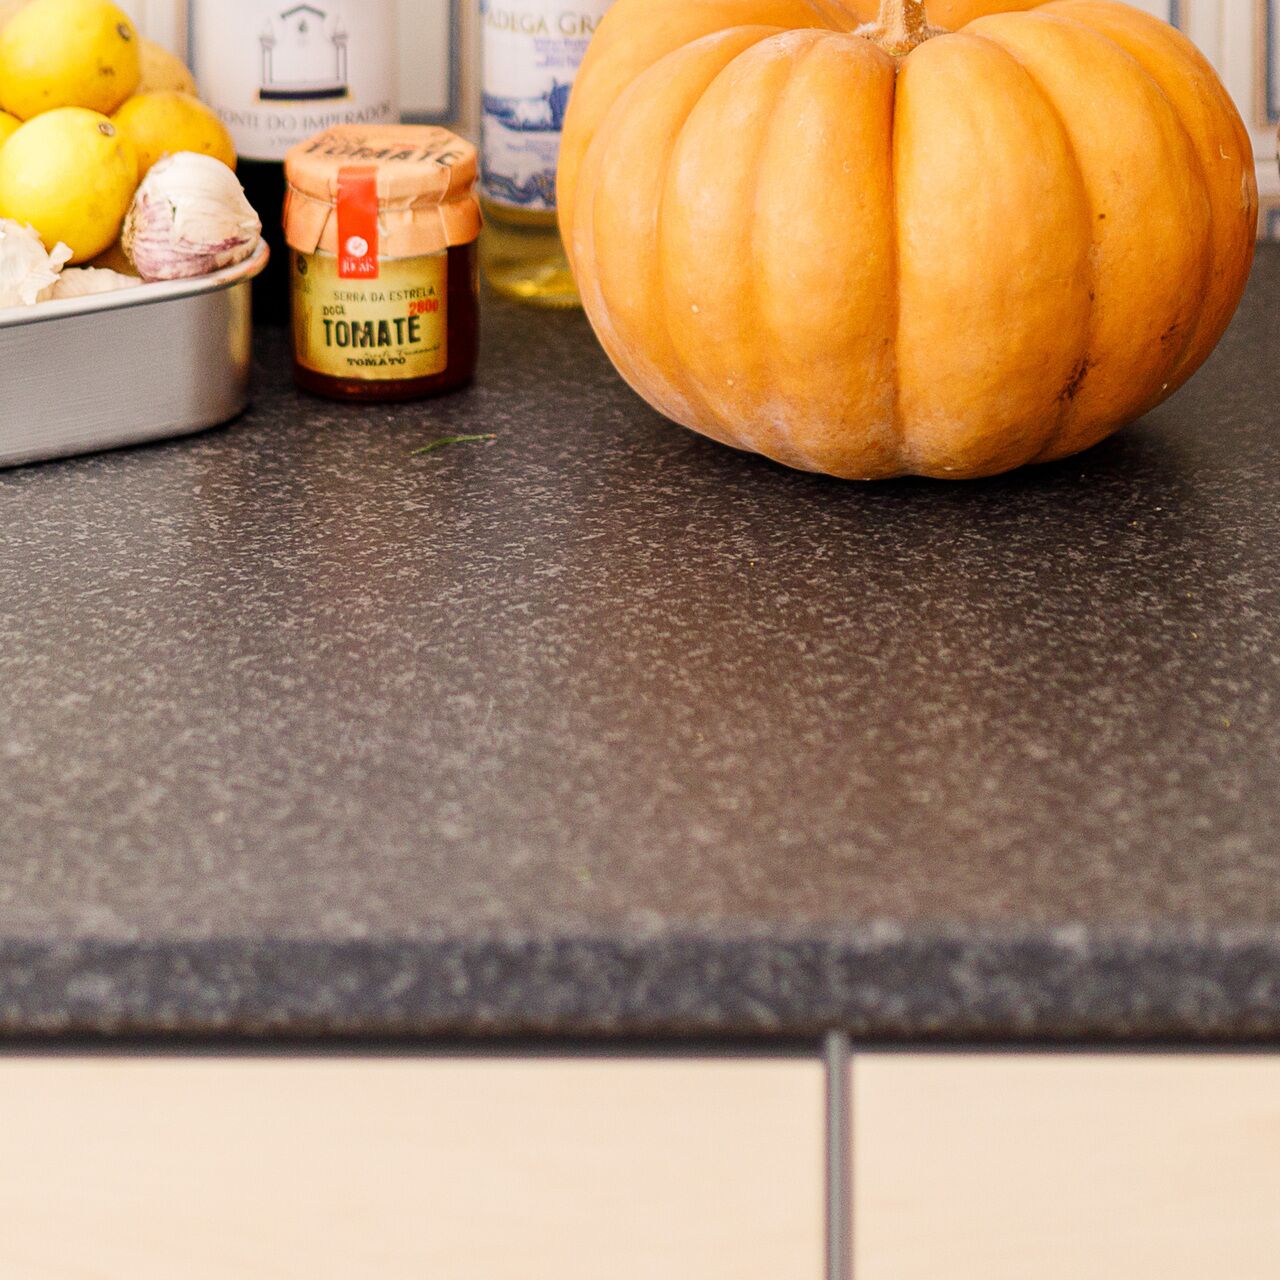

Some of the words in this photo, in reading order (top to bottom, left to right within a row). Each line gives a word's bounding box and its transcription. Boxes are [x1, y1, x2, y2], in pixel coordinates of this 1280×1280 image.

[333, 289, 367, 303] SERRA
[371, 290, 385, 303] DA
[389, 285, 436, 301] ESTRELA
[322, 316, 421, 348] TOMATE
[346, 356, 406, 367] TOMATO
